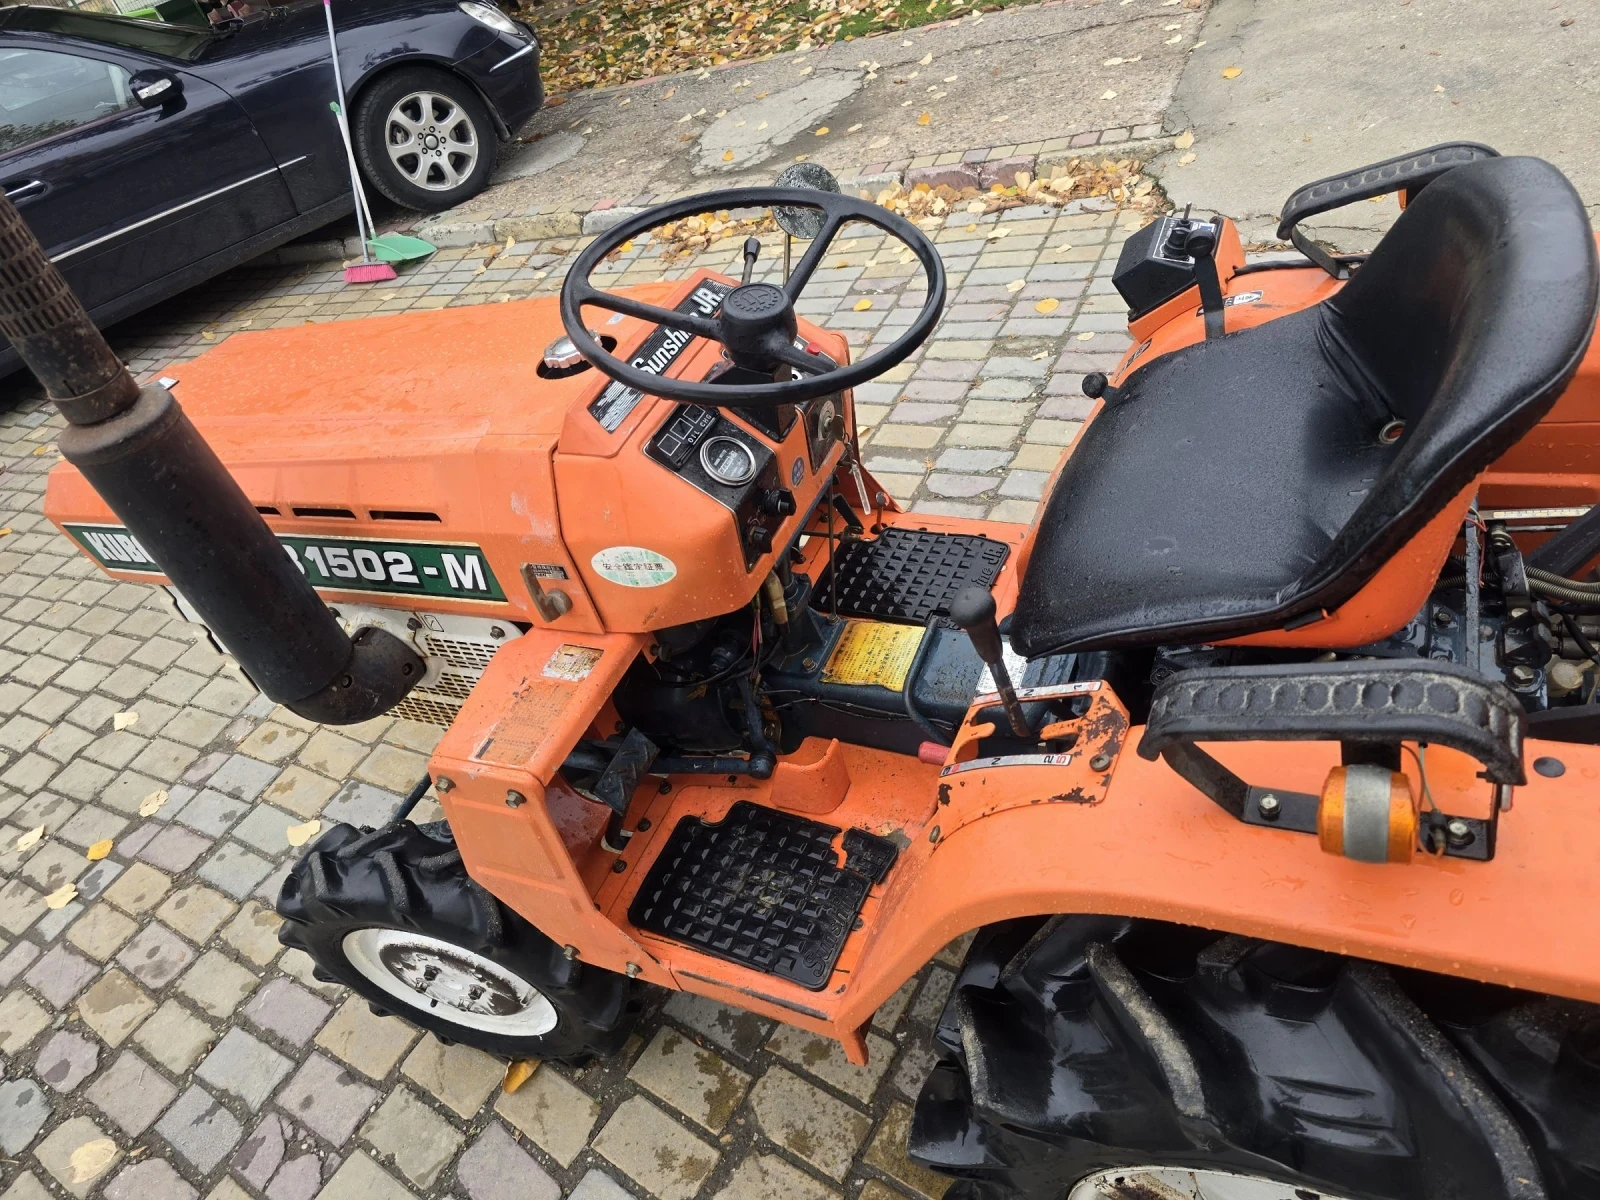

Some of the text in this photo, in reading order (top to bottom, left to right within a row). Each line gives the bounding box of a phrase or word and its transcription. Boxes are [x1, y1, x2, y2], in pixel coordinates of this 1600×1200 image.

[692, 287, 726, 314] JR.
[687, 413, 712, 443] OIL CHG
